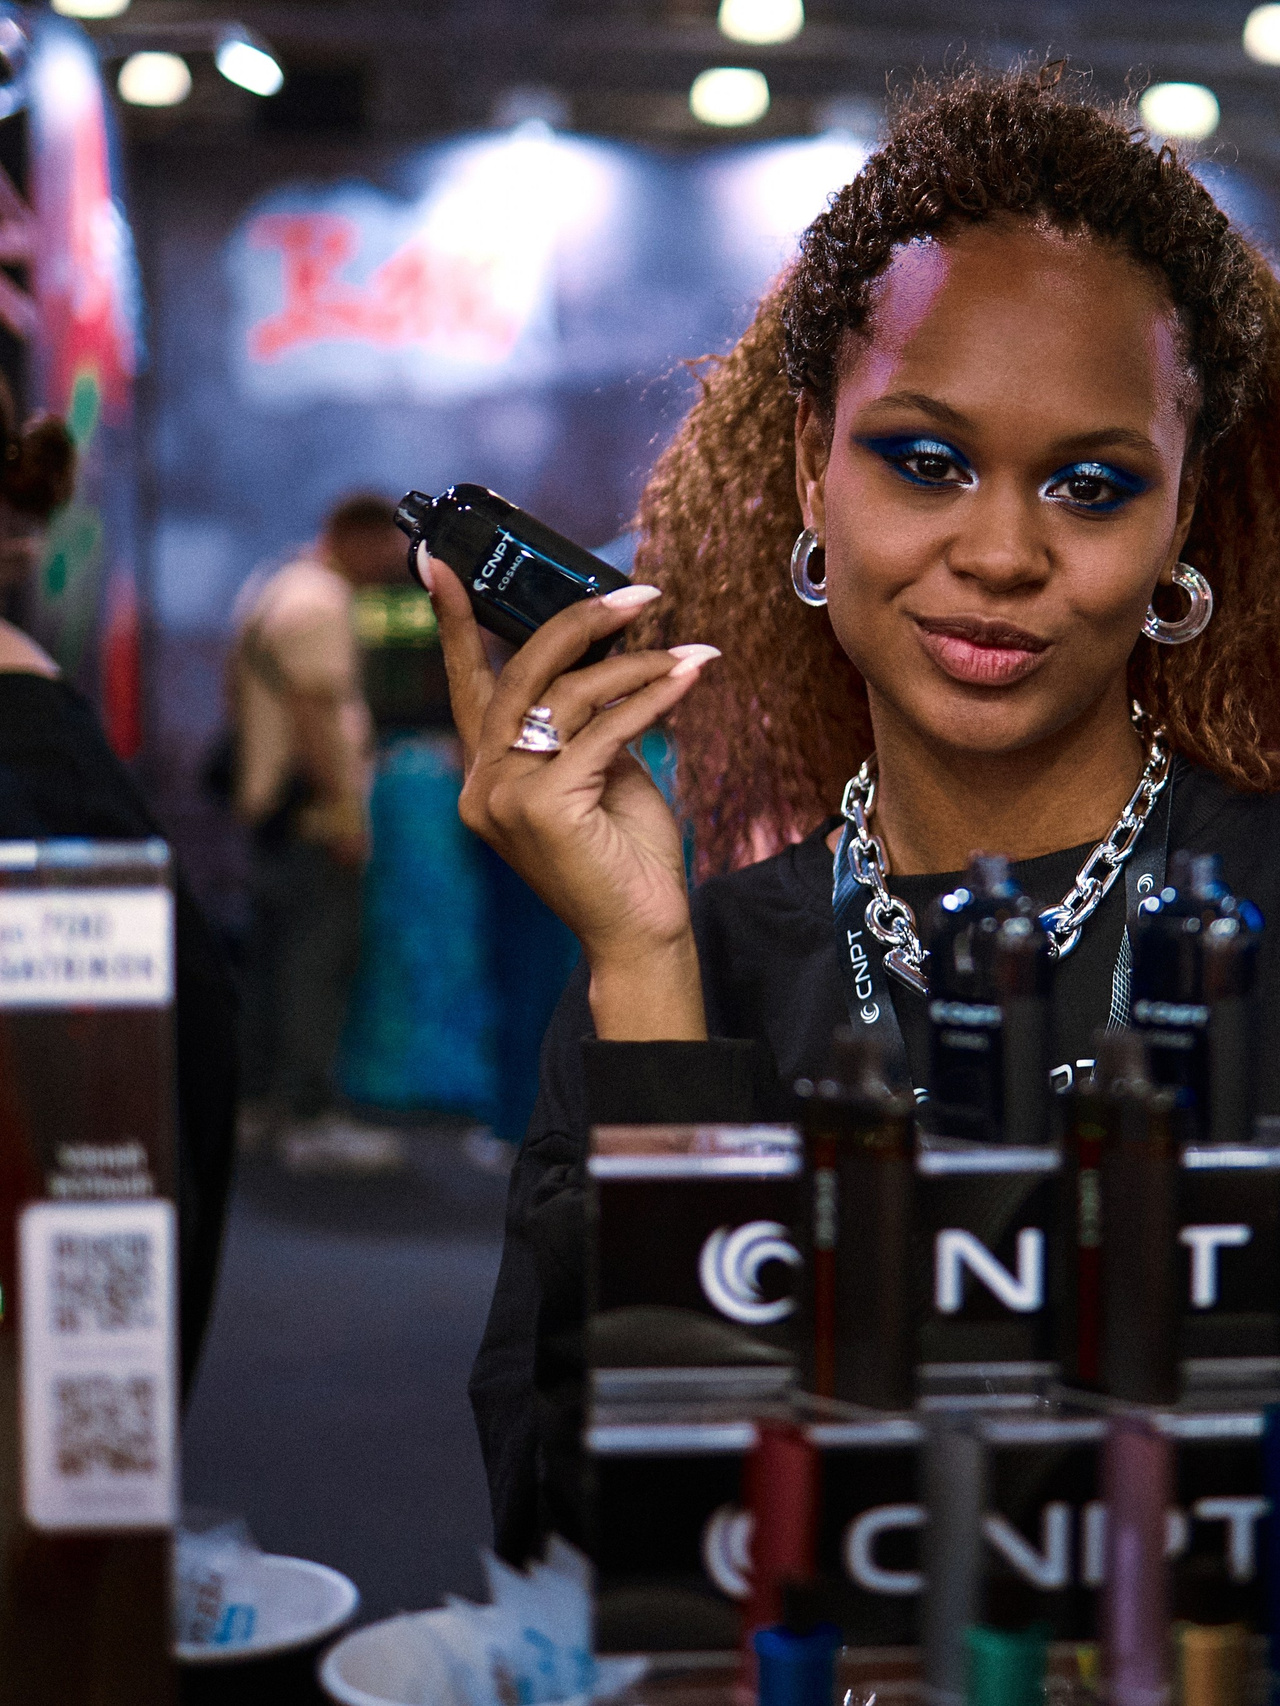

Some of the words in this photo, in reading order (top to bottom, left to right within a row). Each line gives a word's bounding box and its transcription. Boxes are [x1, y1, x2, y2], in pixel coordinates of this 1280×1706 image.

[481, 531, 515, 579] CNPT
[497, 555, 524, 591] COSMO
[847, 929, 873, 1000] CNPT
